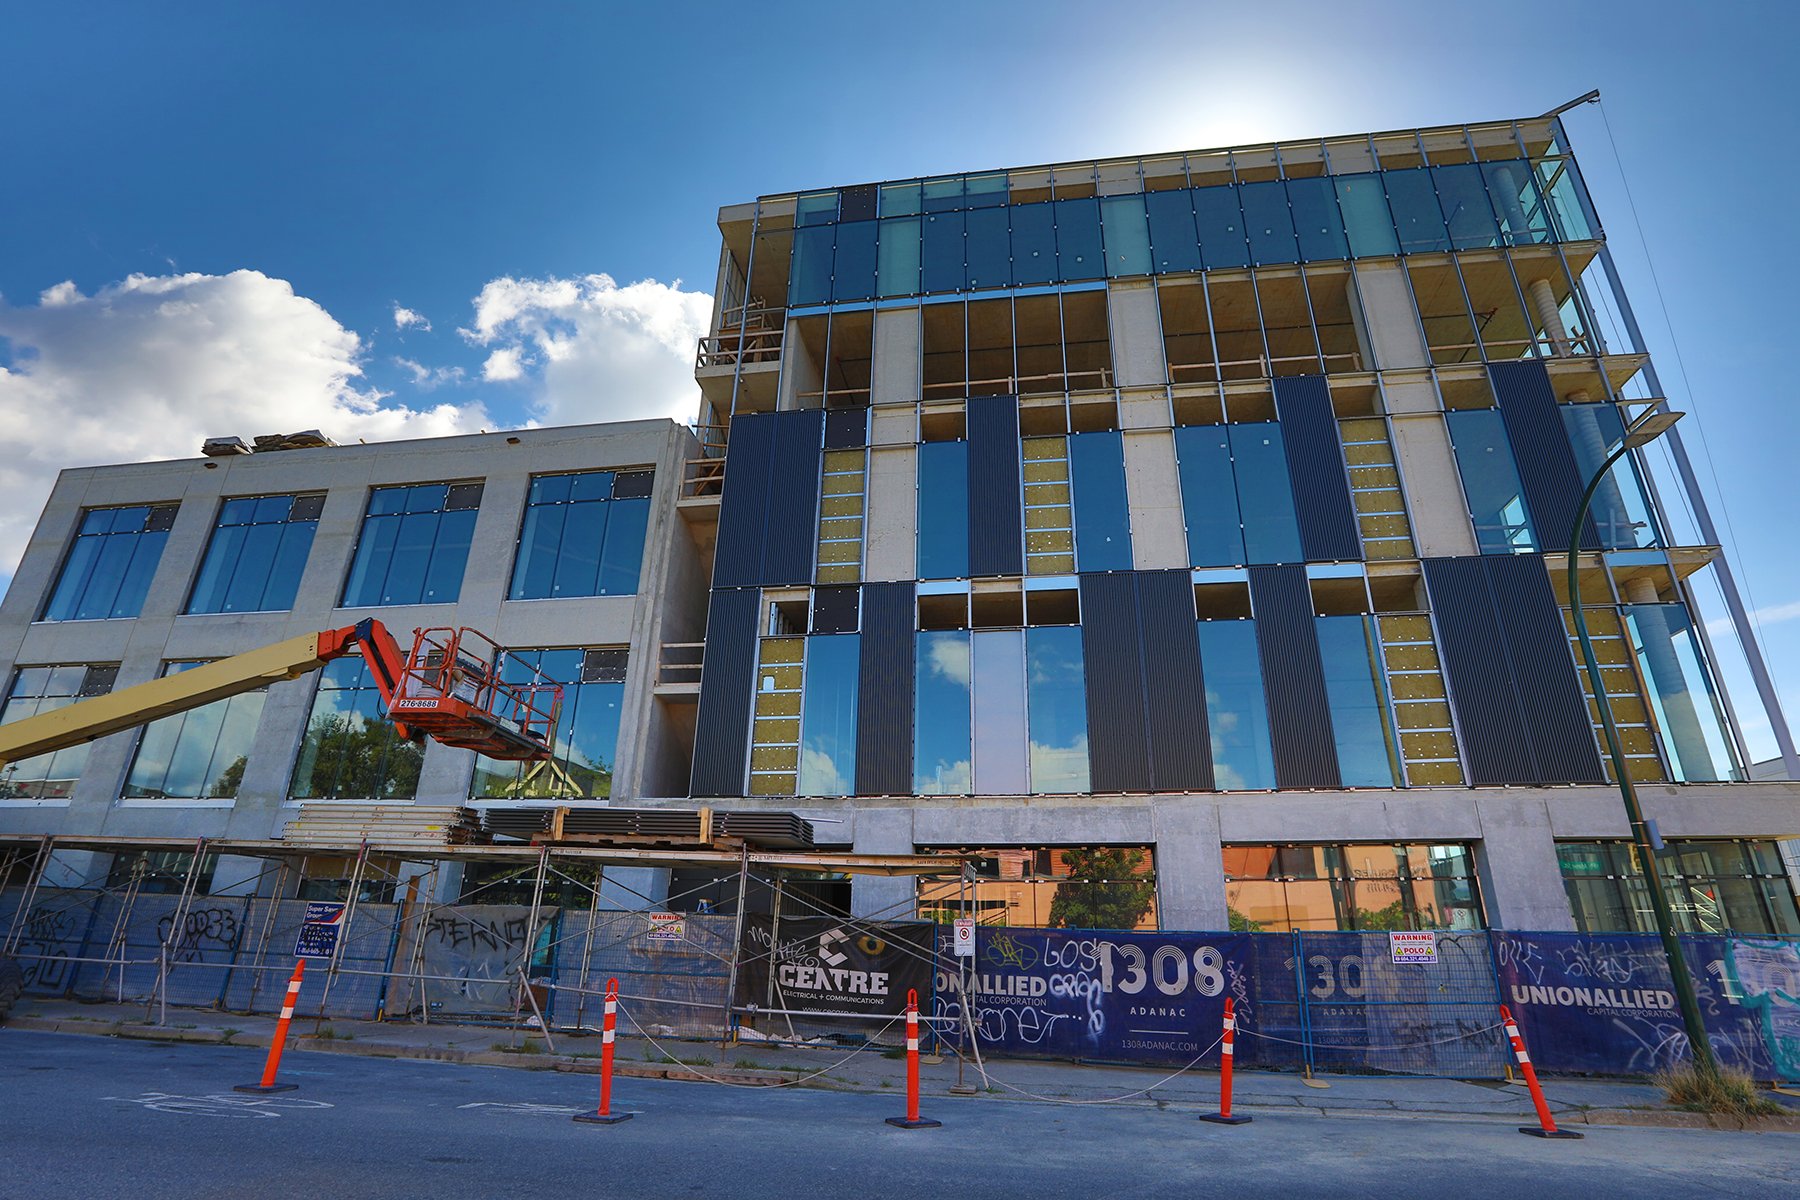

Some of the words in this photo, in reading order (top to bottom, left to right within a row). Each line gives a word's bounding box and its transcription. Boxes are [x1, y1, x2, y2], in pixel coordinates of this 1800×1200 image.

[1089, 942, 1225, 997] 1308
[779, 964, 889, 995] CENTRE
[783, 989, 817, 1000] ELECTRICAL
[825, 994, 885, 1005] COMMUNICATIONS
[990, 996, 1047, 1007] CORPORATION
[1511, 984, 1675, 1009] UNIONALLIED
[1130, 1006, 1186, 1017] ADANAC
[1587, 1007, 1620, 1017] CAPITAL
[1621, 1008, 1680, 1018] CORPORATION
[1122, 1039, 1198, 1051] 1308ADANAC.COM
